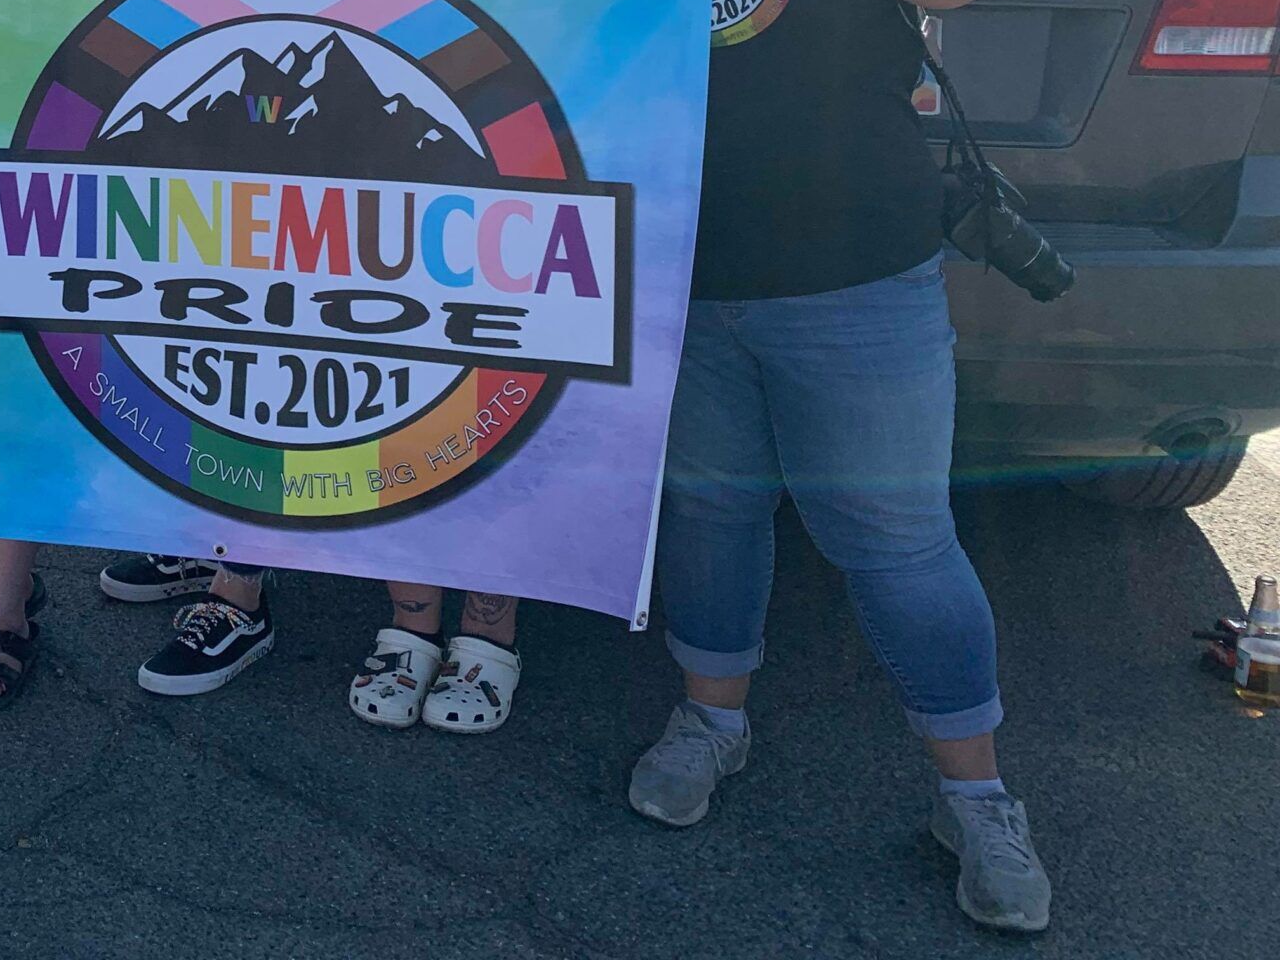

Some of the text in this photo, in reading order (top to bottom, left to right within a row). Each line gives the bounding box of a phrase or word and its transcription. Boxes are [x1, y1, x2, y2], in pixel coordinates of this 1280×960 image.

[245, 94, 283, 124] W
[47, 267, 530, 349] PRIDE
[61, 345, 528, 499] A SMALL TOWN WITH BIG HEARTS
[163, 343, 411, 429] EST.2021
